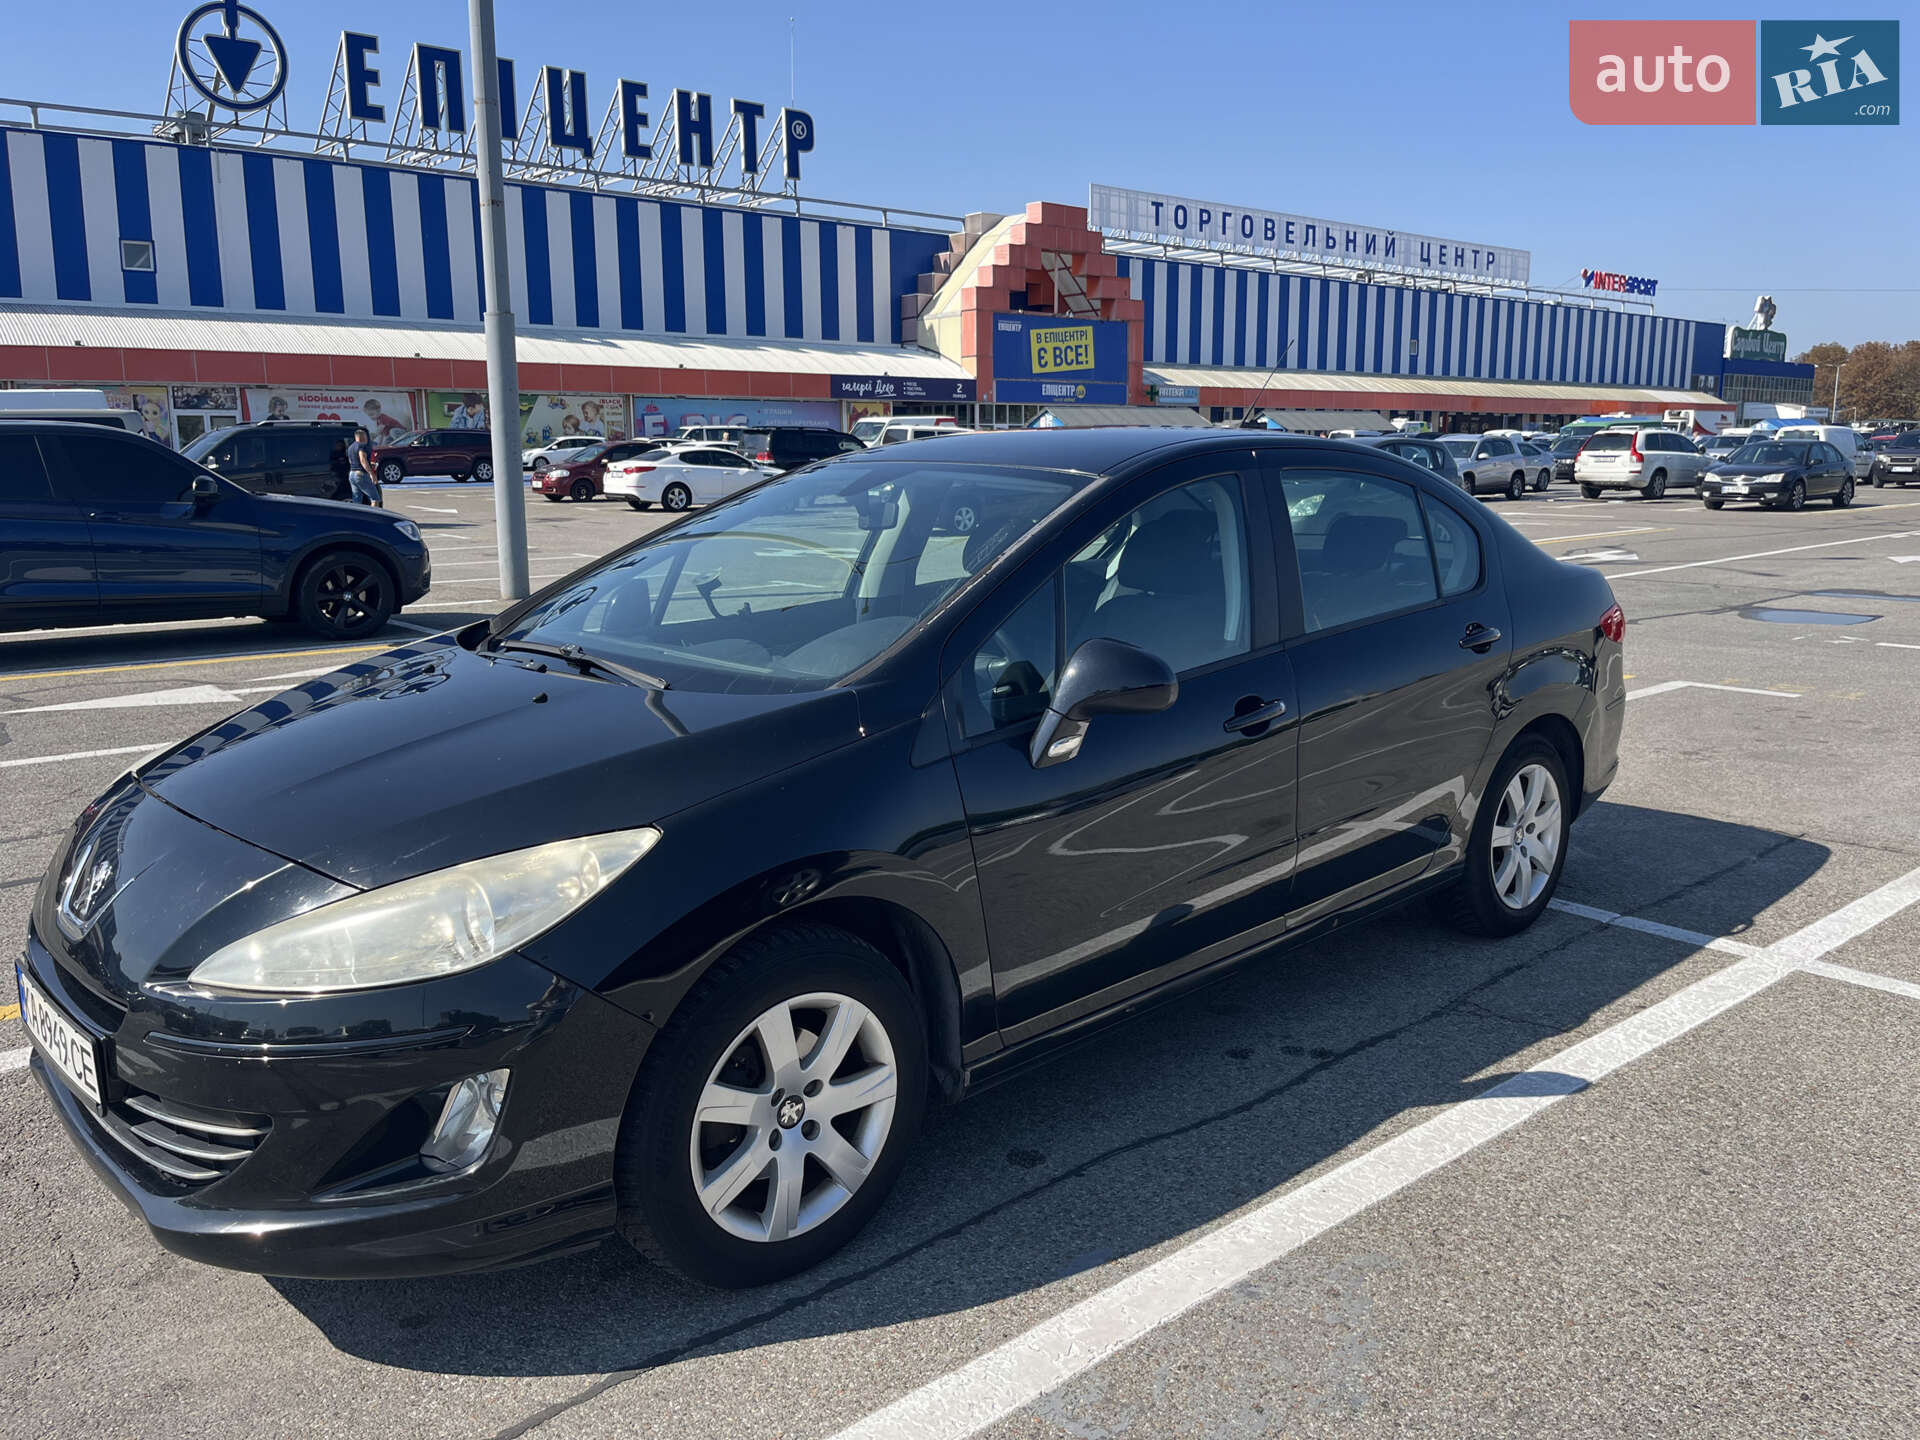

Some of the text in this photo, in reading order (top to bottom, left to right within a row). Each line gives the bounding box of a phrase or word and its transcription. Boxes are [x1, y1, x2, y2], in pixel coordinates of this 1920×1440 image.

[341, 30, 814, 180] ЕПІЦЕНТР
[1151, 201, 1496, 271] ТОРГОВЕЛЬНИЙ ЦЕНТР
[1592, 270, 1658, 296] INTERSPORT
[1036, 330, 1088, 344] В ЕПІЦЕНТРІ
[1037, 344, 1089, 368] Є ВСЕ!
[956, 384, 963, 393] 2
[1042, 384, 1075, 397] ЕПІЦЕНТР
